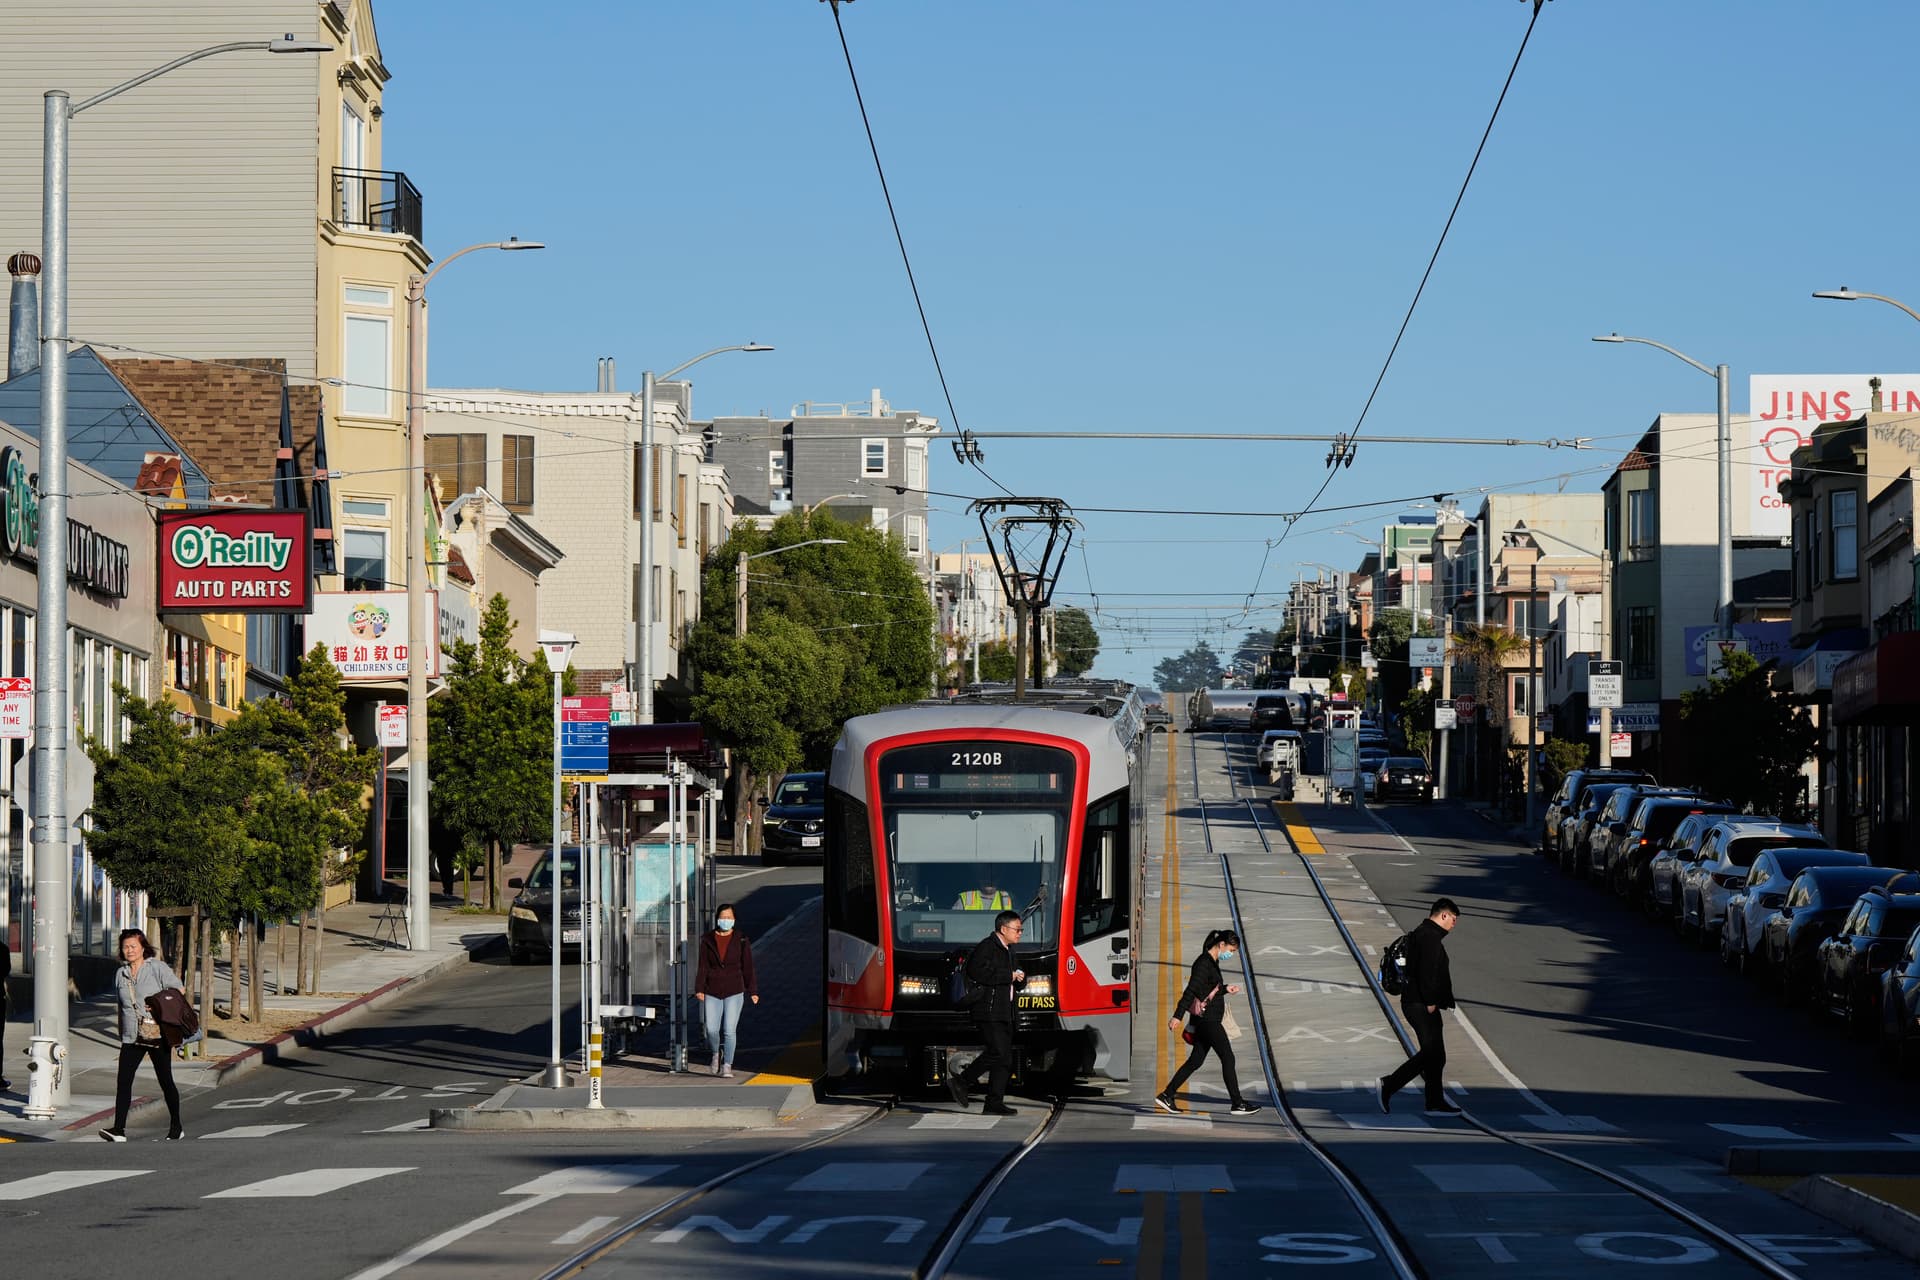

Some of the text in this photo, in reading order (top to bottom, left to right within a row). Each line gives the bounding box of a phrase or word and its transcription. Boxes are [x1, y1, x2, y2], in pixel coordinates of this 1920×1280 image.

[172, 526, 291, 570] O'Reilly
[95, 536, 129, 598] PARTS
[175, 580, 291, 597] AUTO PARTS
[344, 664, 393, 672] CHILDREN'S
[3, 704, 19, 712] ANY
[1592, 715, 1657, 725] DTISTRY
[951, 752, 1002, 766] 2120B
[1032, 996, 1055, 1008] PASS
[212, 1082, 489, 1110] STOP
